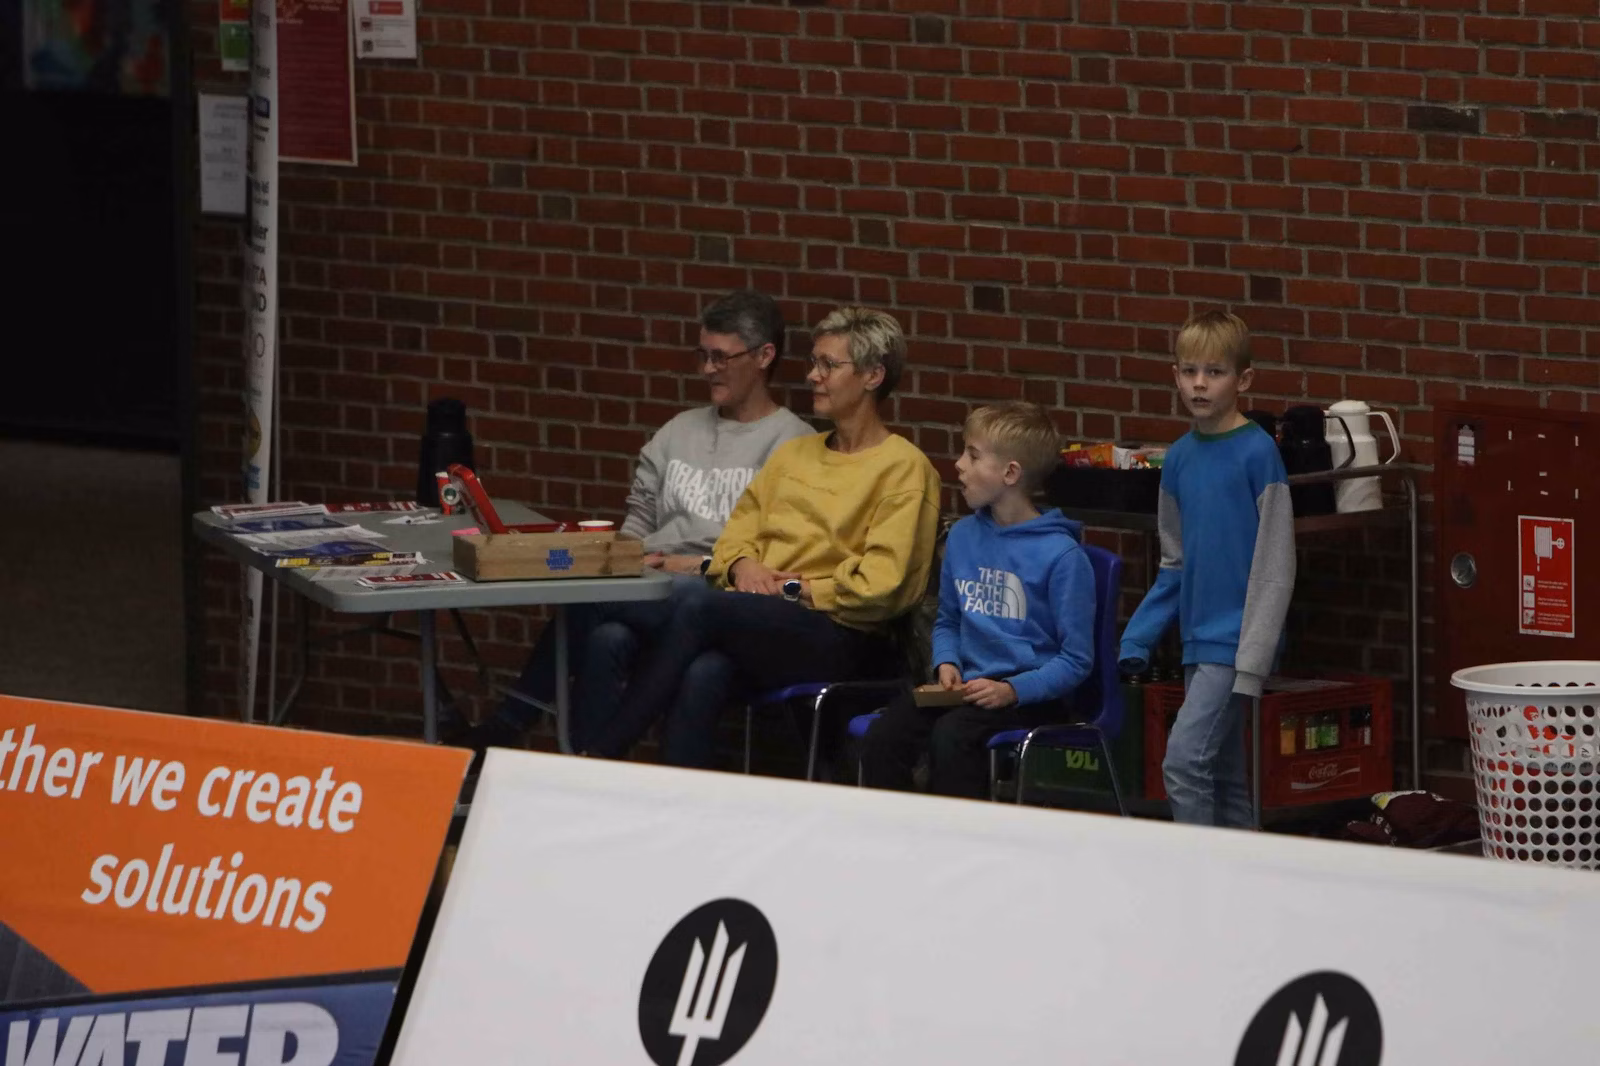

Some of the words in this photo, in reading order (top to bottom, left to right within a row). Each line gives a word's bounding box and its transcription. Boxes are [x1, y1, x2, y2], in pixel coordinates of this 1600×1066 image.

[978, 567, 1003, 586] THE
[954, 578, 1003, 601] NORTH
[964, 596, 1003, 617] FACE
[0, 723, 104, 799] ther
[110, 755, 186, 812] we
[197, 766, 363, 833] create
[81, 842, 333, 933] solutions
